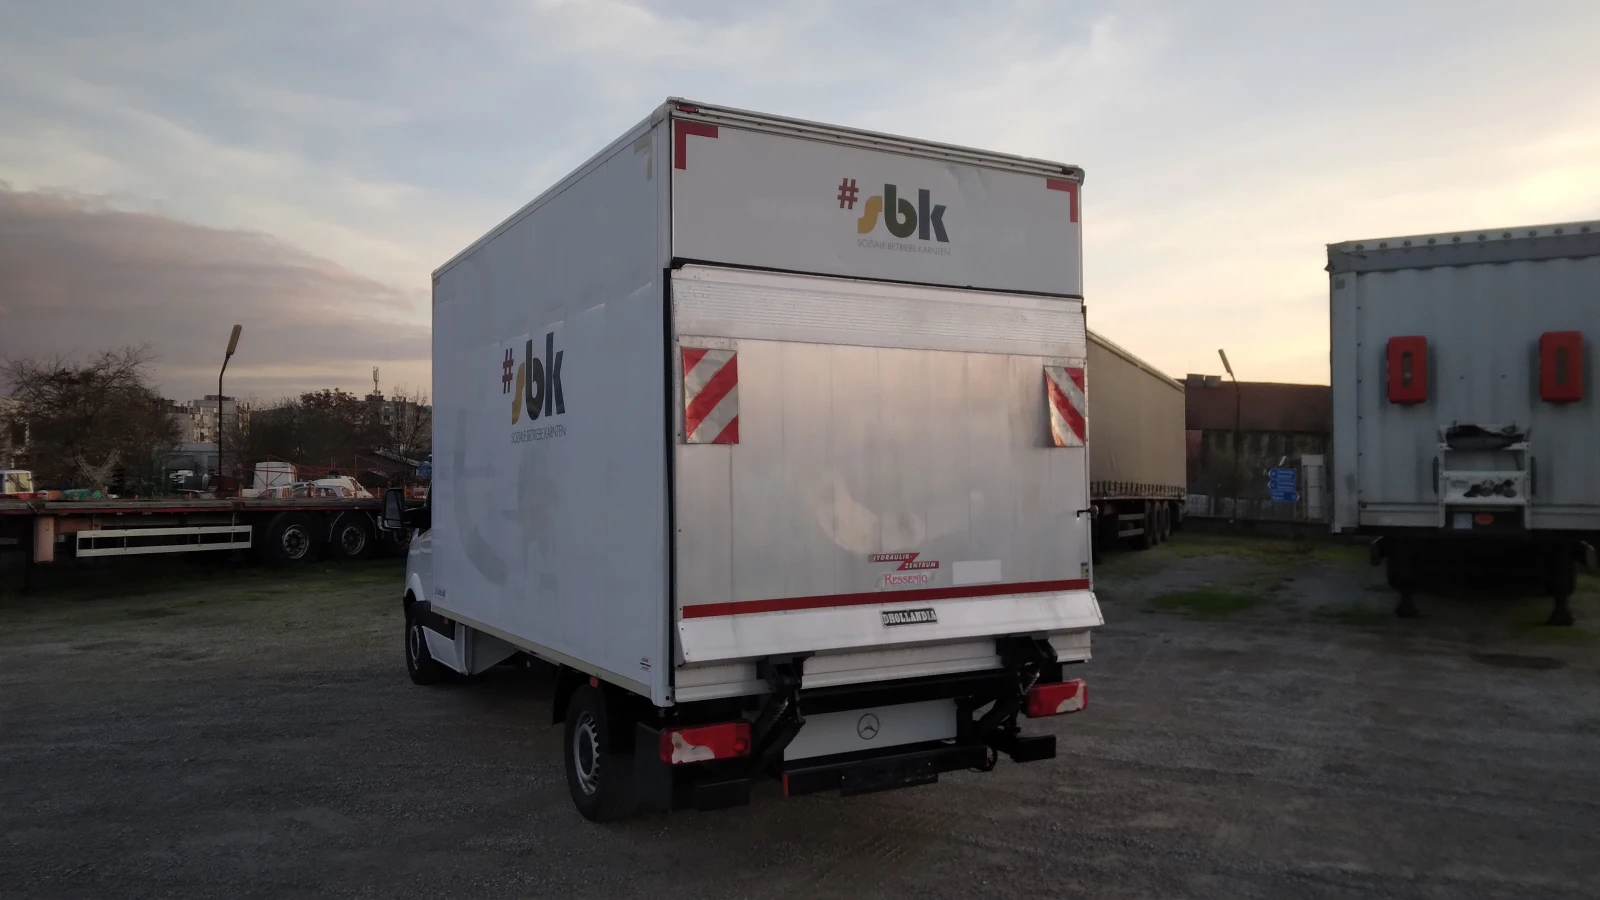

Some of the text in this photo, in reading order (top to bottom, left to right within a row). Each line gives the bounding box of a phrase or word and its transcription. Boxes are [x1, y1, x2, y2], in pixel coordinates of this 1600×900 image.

[837, 178, 950, 243] #sbk
[857, 239, 886, 250] SOZIALE
[887, 242, 917, 253] BETRIEBE
[502, 331, 565, 425] #sbk
[904, 561, 936, 569] ZENTRUM
[882, 610, 937, 624] DHOLLANDIA
